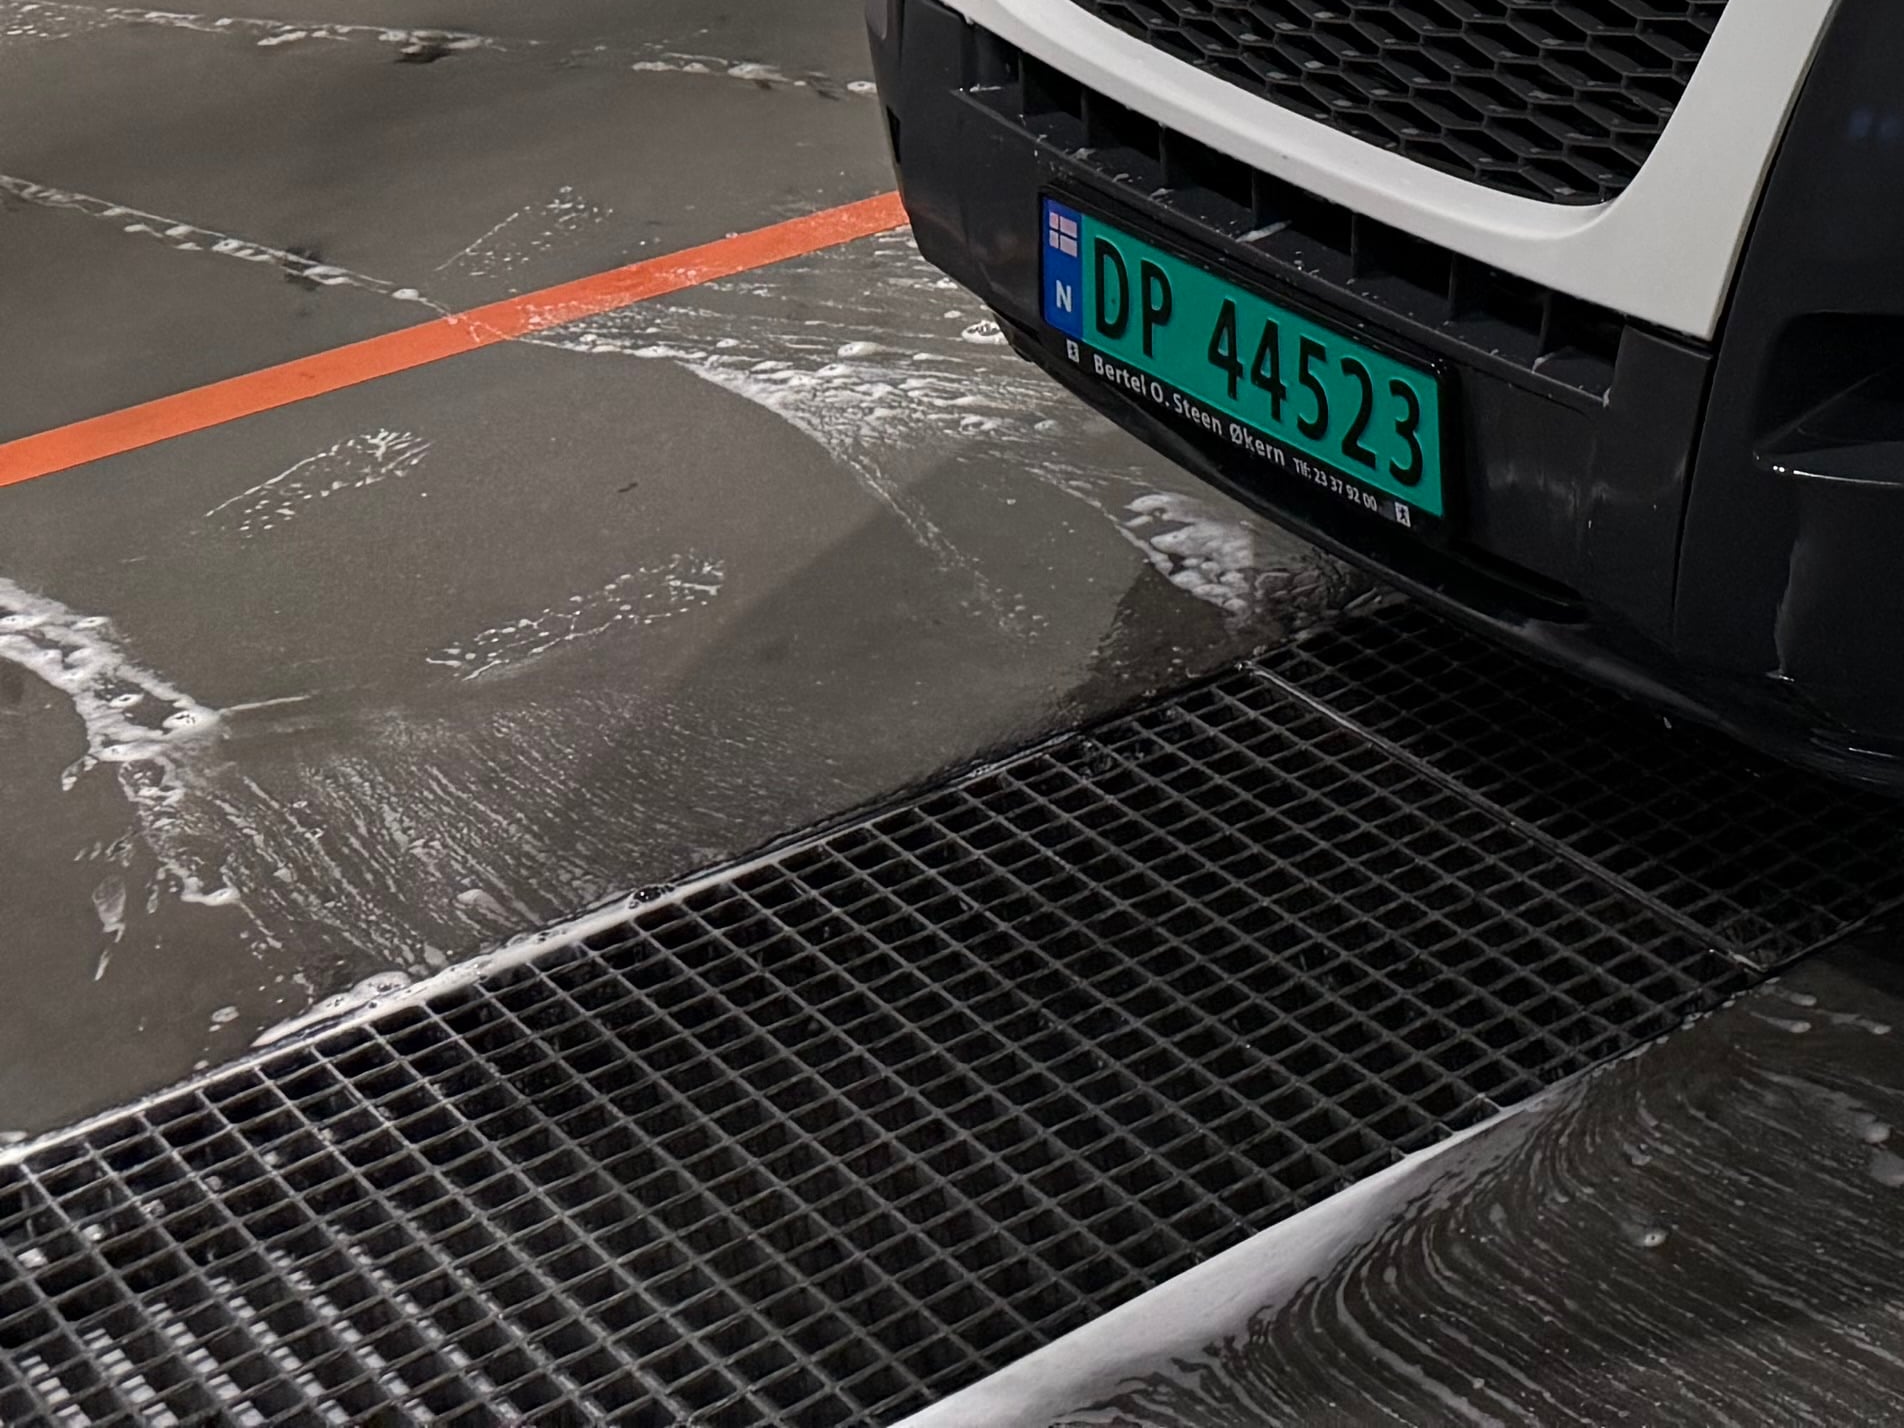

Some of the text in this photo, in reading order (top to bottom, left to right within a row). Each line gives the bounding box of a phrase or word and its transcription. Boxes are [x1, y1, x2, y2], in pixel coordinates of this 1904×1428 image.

[1055, 279, 1072, 313] N
[1094, 237, 1424, 487] DP 44523
[1093, 353, 1147, 396] Bertel
[1150, 381, 1171, 408] O.
[1173, 392, 1223, 436] Steen
[1229, 422, 1286, 467] Økern
[1313, 467, 1328, 487] 23
[1329, 475, 1343, 495] 37
[1345, 484, 1361, 504] 92
[1362, 492, 1378, 513] 00
